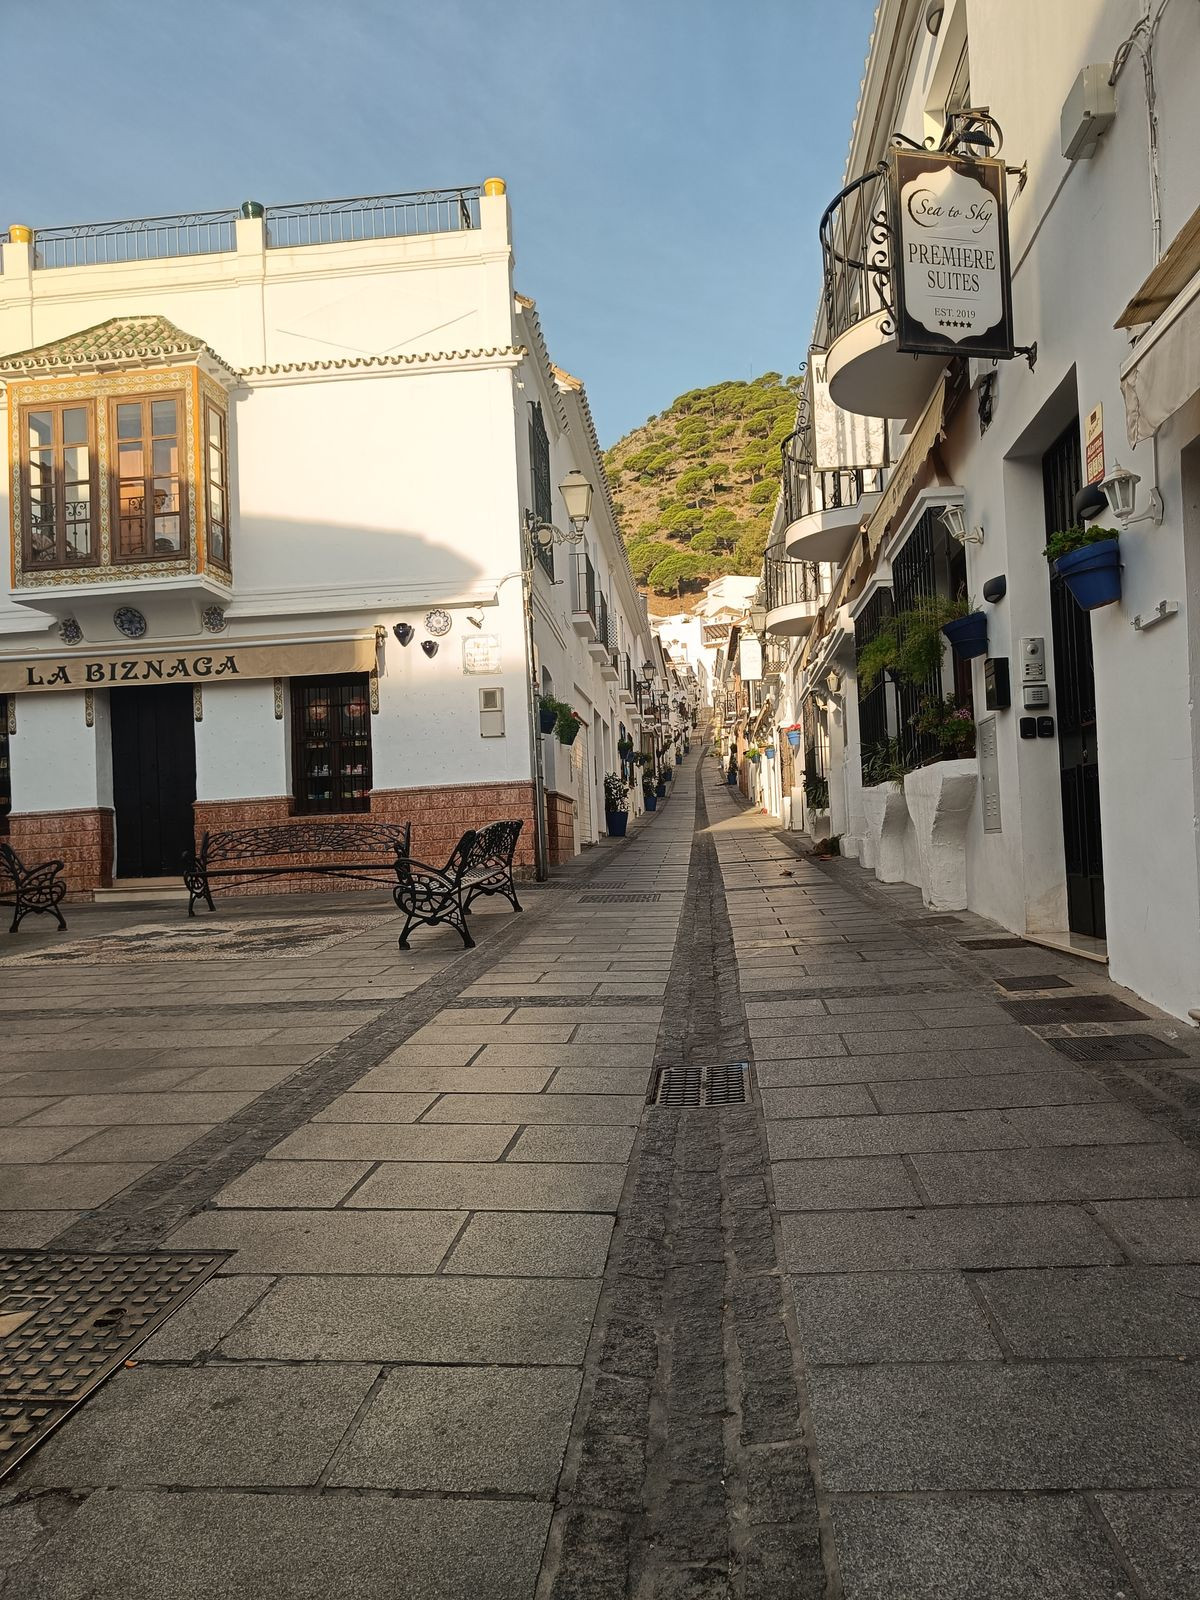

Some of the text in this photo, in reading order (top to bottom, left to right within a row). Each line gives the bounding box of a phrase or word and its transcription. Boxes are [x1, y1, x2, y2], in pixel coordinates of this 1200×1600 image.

[916, 199, 993, 234] Sea to Sky
[908, 243, 996, 271] PREMIERE
[927, 270, 980, 292] SUITES
[934, 307, 976, 319] EST. 2019
[26, 655, 239, 686] LA BIZNAGA
